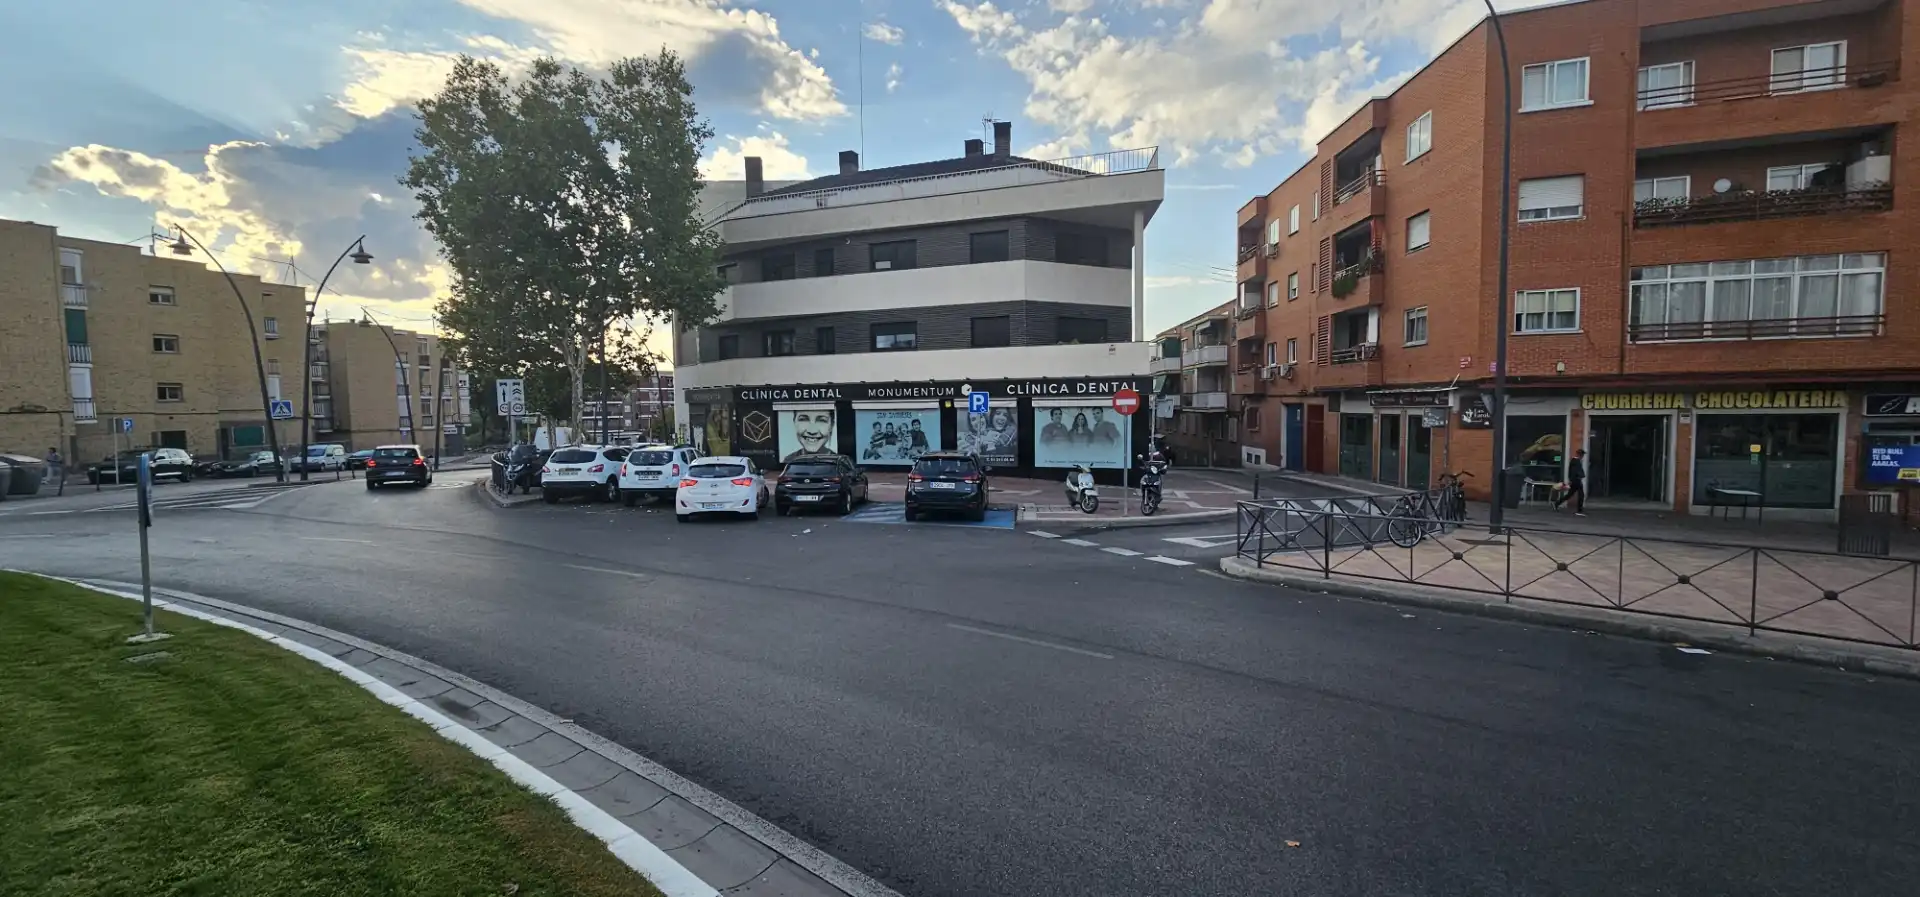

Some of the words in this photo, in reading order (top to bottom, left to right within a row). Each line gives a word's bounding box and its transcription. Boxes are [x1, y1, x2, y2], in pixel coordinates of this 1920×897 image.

[741, 388, 789, 400] CLÍNICA
[794, 388, 842, 399] DENTAL
[868, 387, 954, 397] MONUMENTUM
[1006, 382, 1069, 395] CLÍNICA
[1076, 381, 1140, 393] DENTAL
[973, 394, 984, 411] P
[1582, 393, 1685, 409] CHURRERIA
[1695, 391, 1847, 409] CHOCOLATERIA
